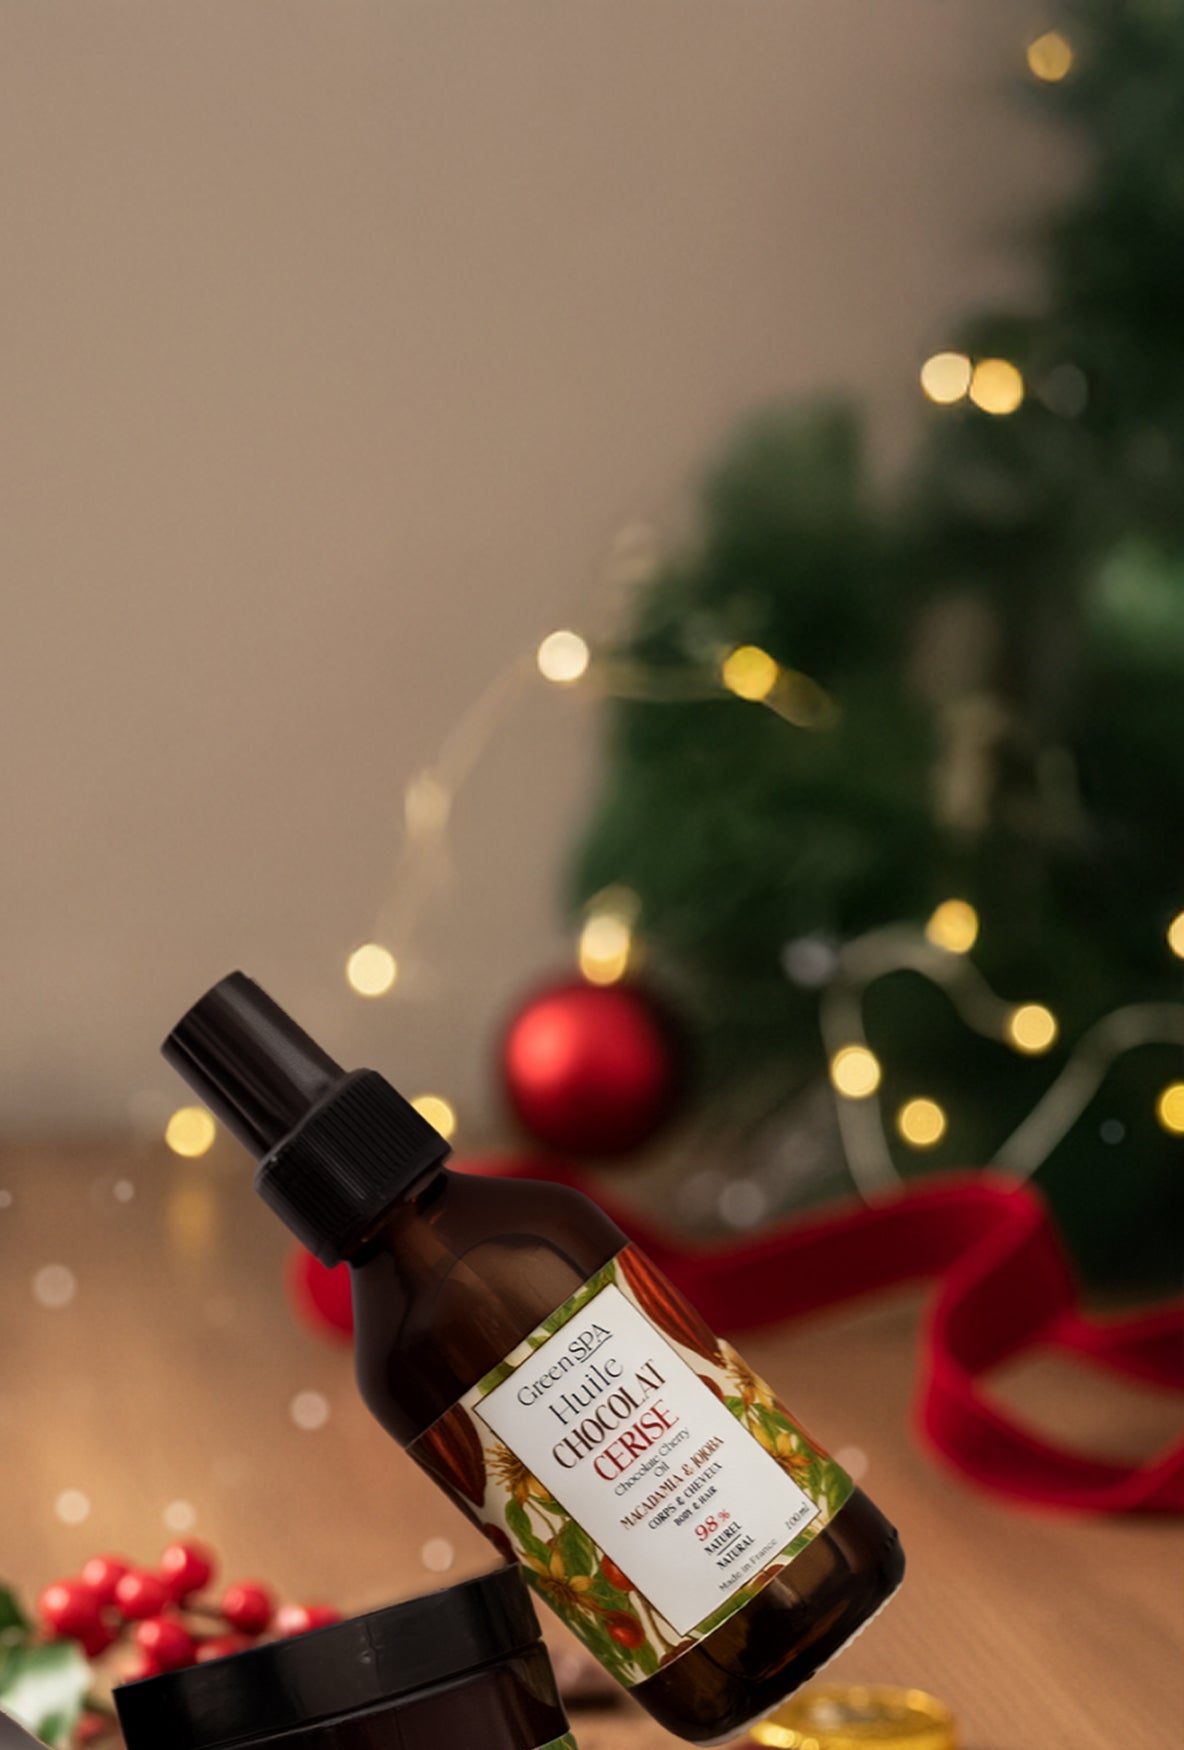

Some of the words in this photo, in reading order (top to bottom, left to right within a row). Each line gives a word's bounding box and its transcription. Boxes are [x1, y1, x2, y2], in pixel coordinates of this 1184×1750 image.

[547, 1358, 623, 1426] Huile
[551, 1359, 666, 1470] CHOCOLAT
[592, 1399, 680, 1482] CERISE
[614, 1454, 661, 1497] Chocolate
[657, 1430, 690, 1457] Cherry
[653, 1460, 671, 1478] Oil
[619, 1474, 685, 1530] MACADAMIA
[680, 1463, 694, 1477] &
[689, 1436, 725, 1469] JOJOBA
[647, 1504, 677, 1530] CORPS
[675, 1496, 686, 1506] &
[682, 1462, 723, 1499] CHEVEUX
[673, 1508, 694, 1527] BODY
[697, 1485, 718, 1505] HAIR
[703, 1521, 742, 1556] NATUREL
[715, 1535, 755, 1571] NATURAL
[718, 1571, 743, 1593] Made
[740, 1562, 753, 1574] in
[748, 1538, 778, 1565] France
